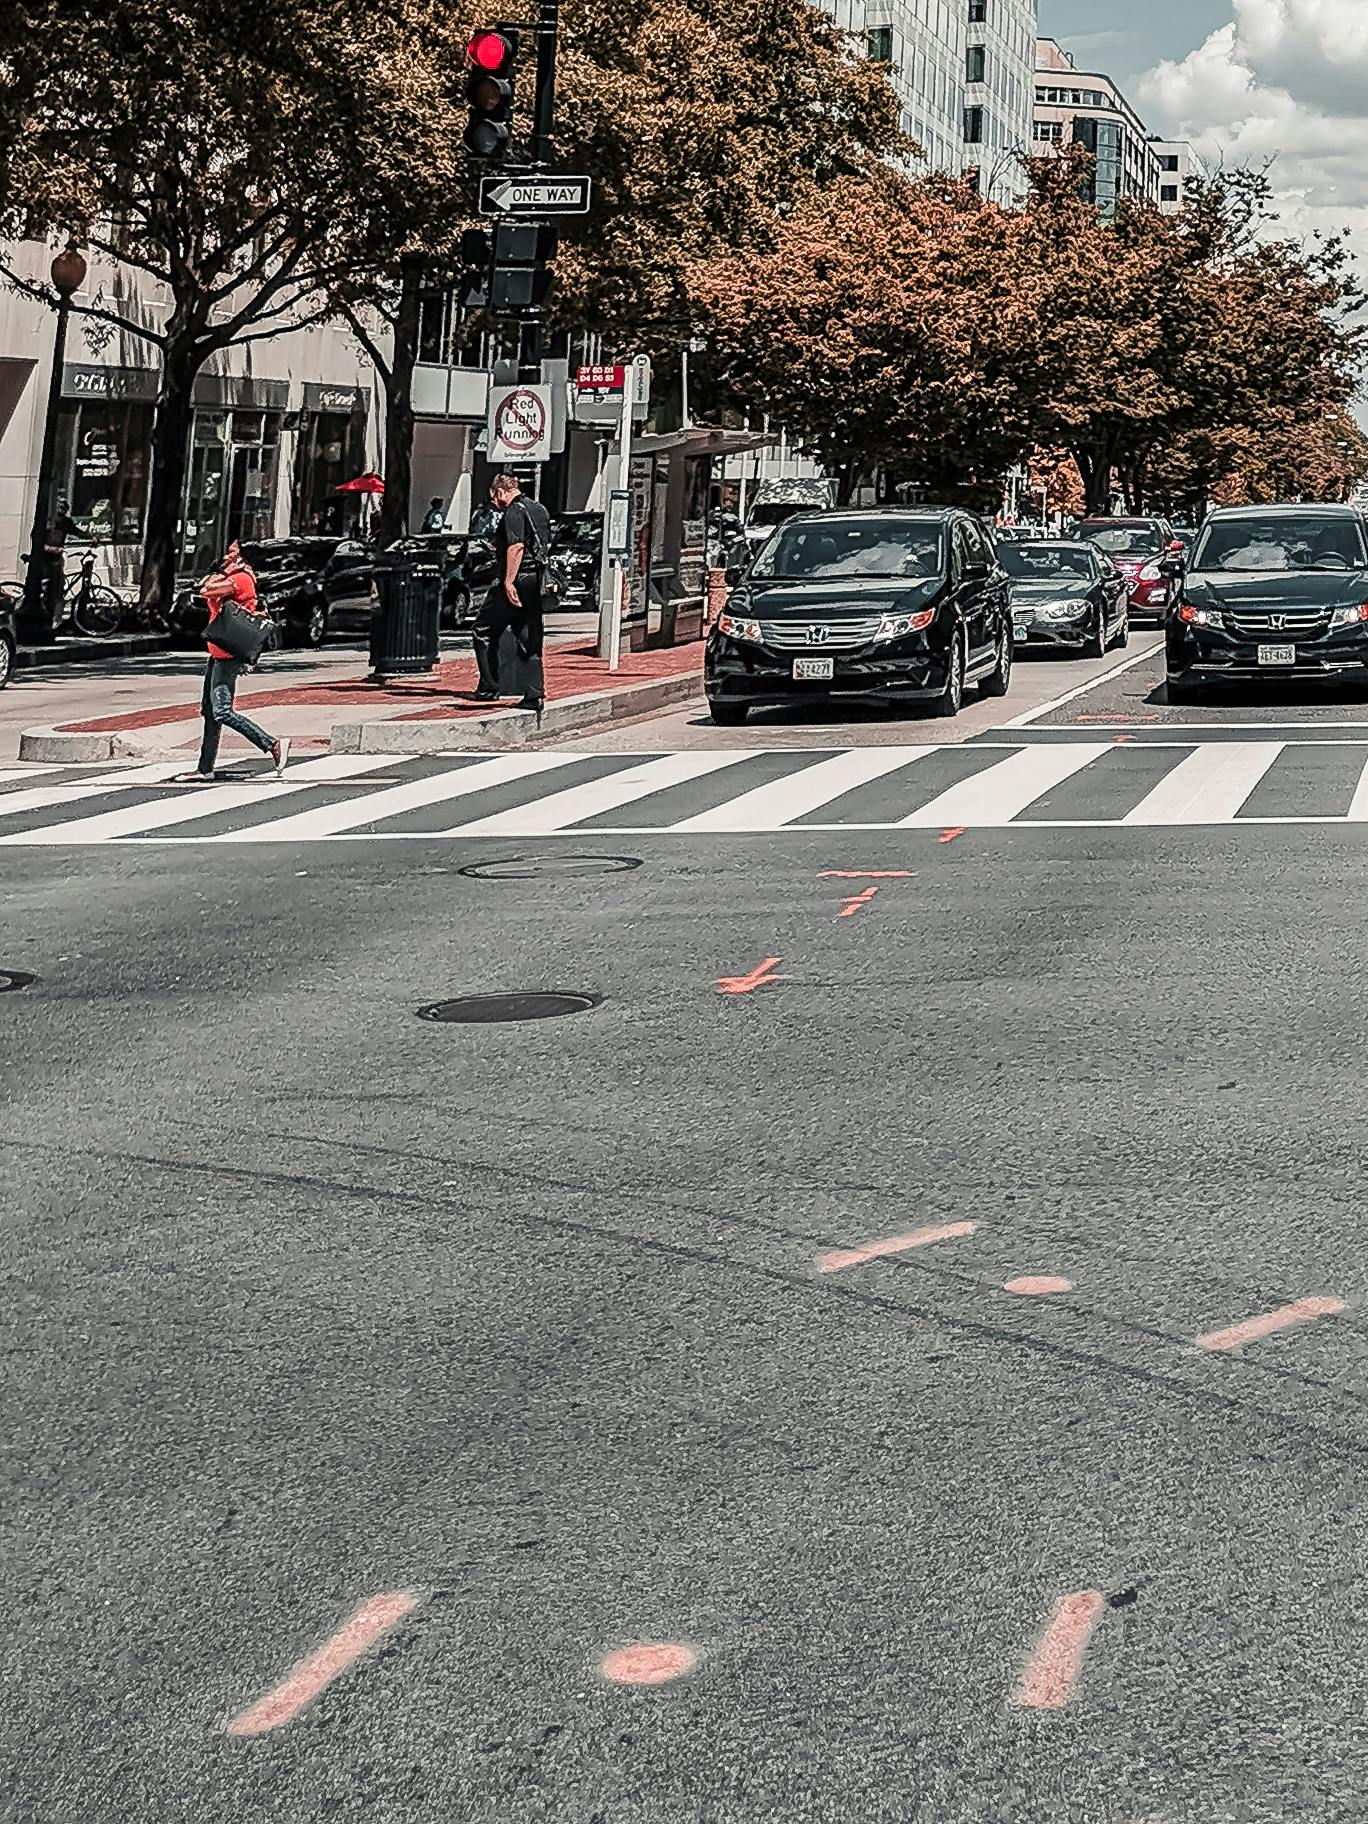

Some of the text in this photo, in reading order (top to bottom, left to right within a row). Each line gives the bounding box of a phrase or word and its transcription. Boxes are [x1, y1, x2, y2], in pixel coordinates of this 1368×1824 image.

[512, 188, 577, 201] ONE WAY
[510, 397, 534, 410] Red
[505, 412, 537, 426] Light
[494, 428, 545, 441] Running
